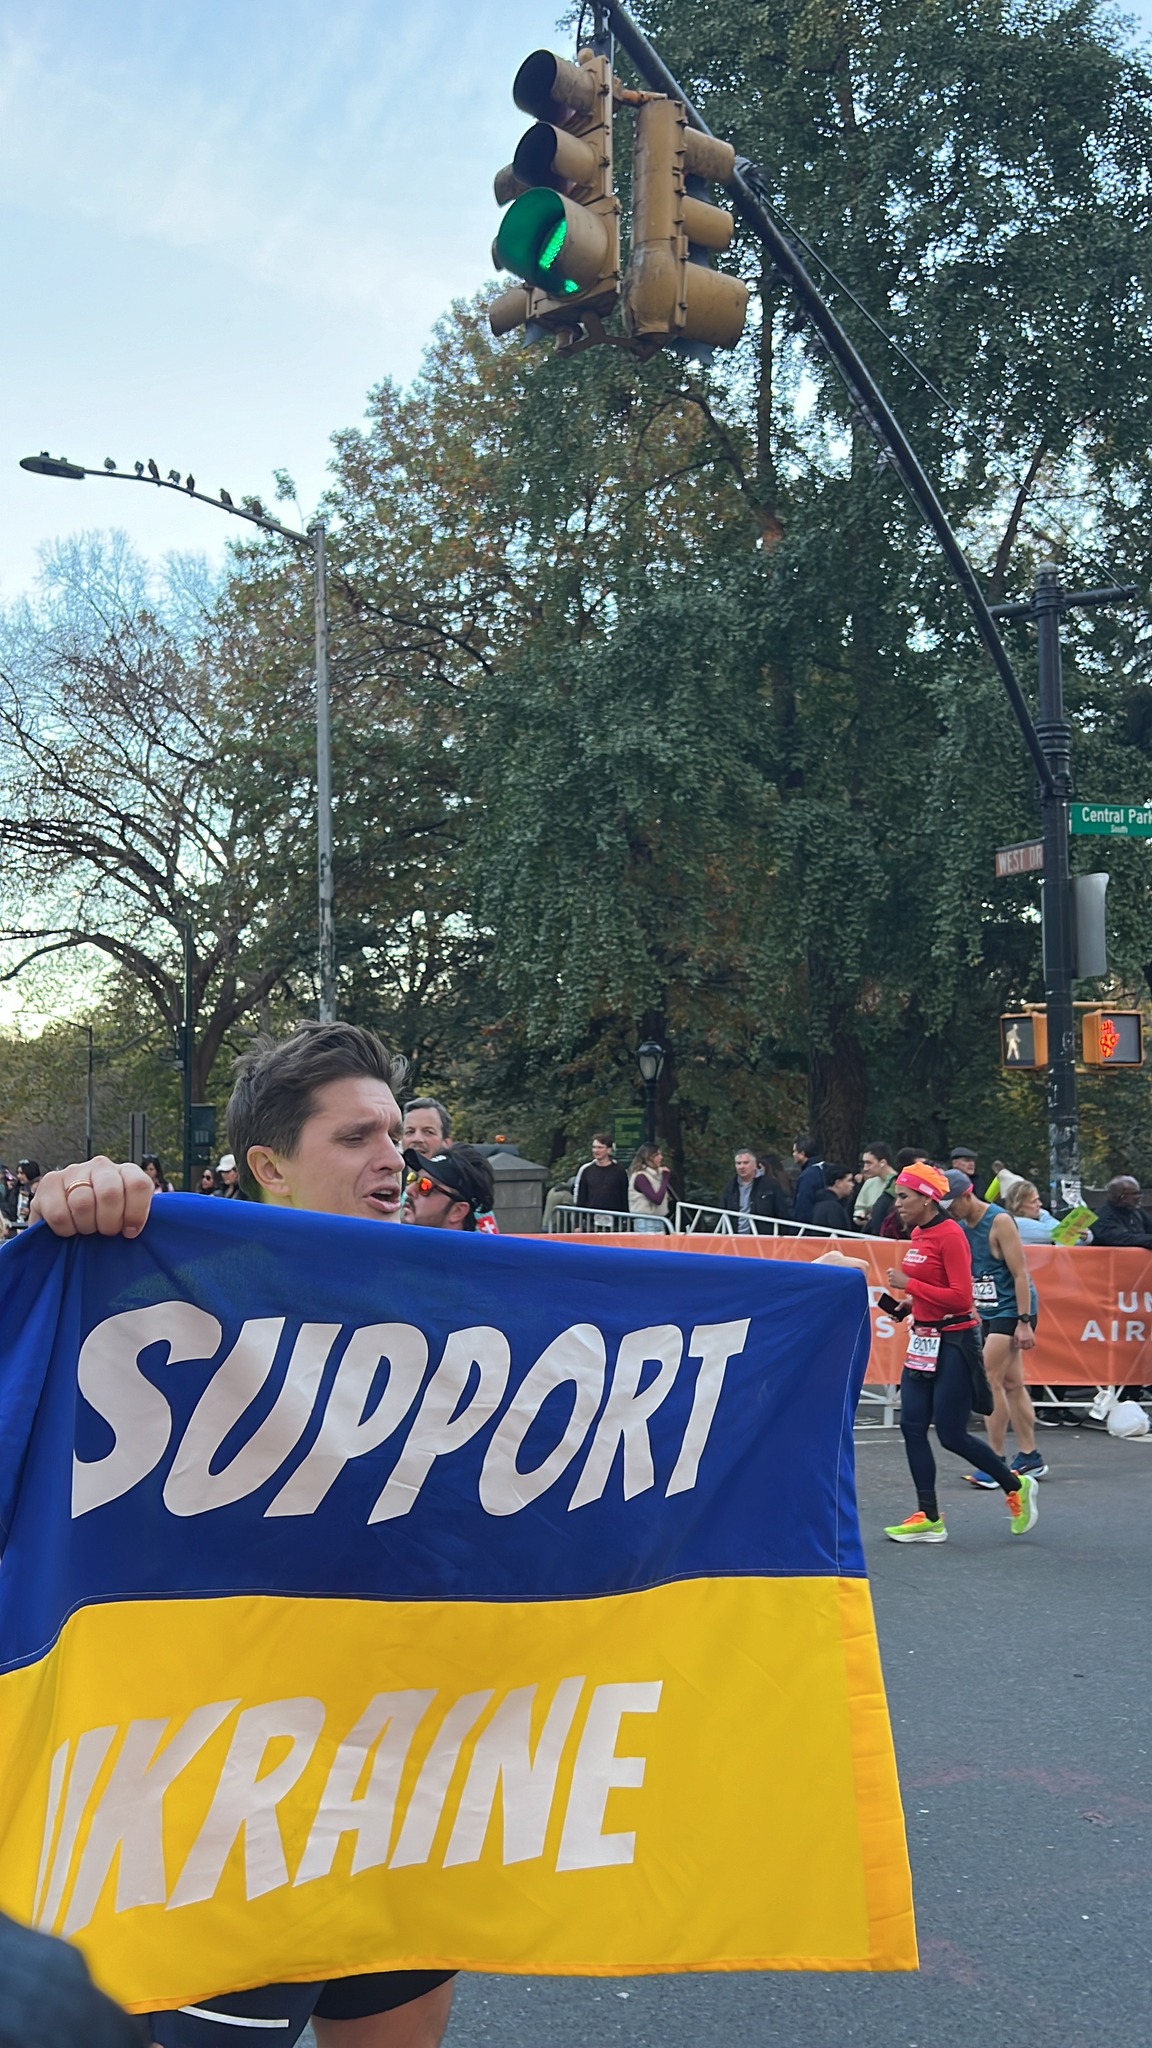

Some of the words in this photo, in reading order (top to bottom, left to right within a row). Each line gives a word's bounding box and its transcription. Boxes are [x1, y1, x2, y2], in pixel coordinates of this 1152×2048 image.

[1081, 806, 1124, 824] Central
[998, 848, 1025, 875] WEST
[1029, 844, 1044, 870] DR
[71, 1300, 752, 1526] SUPPORT
